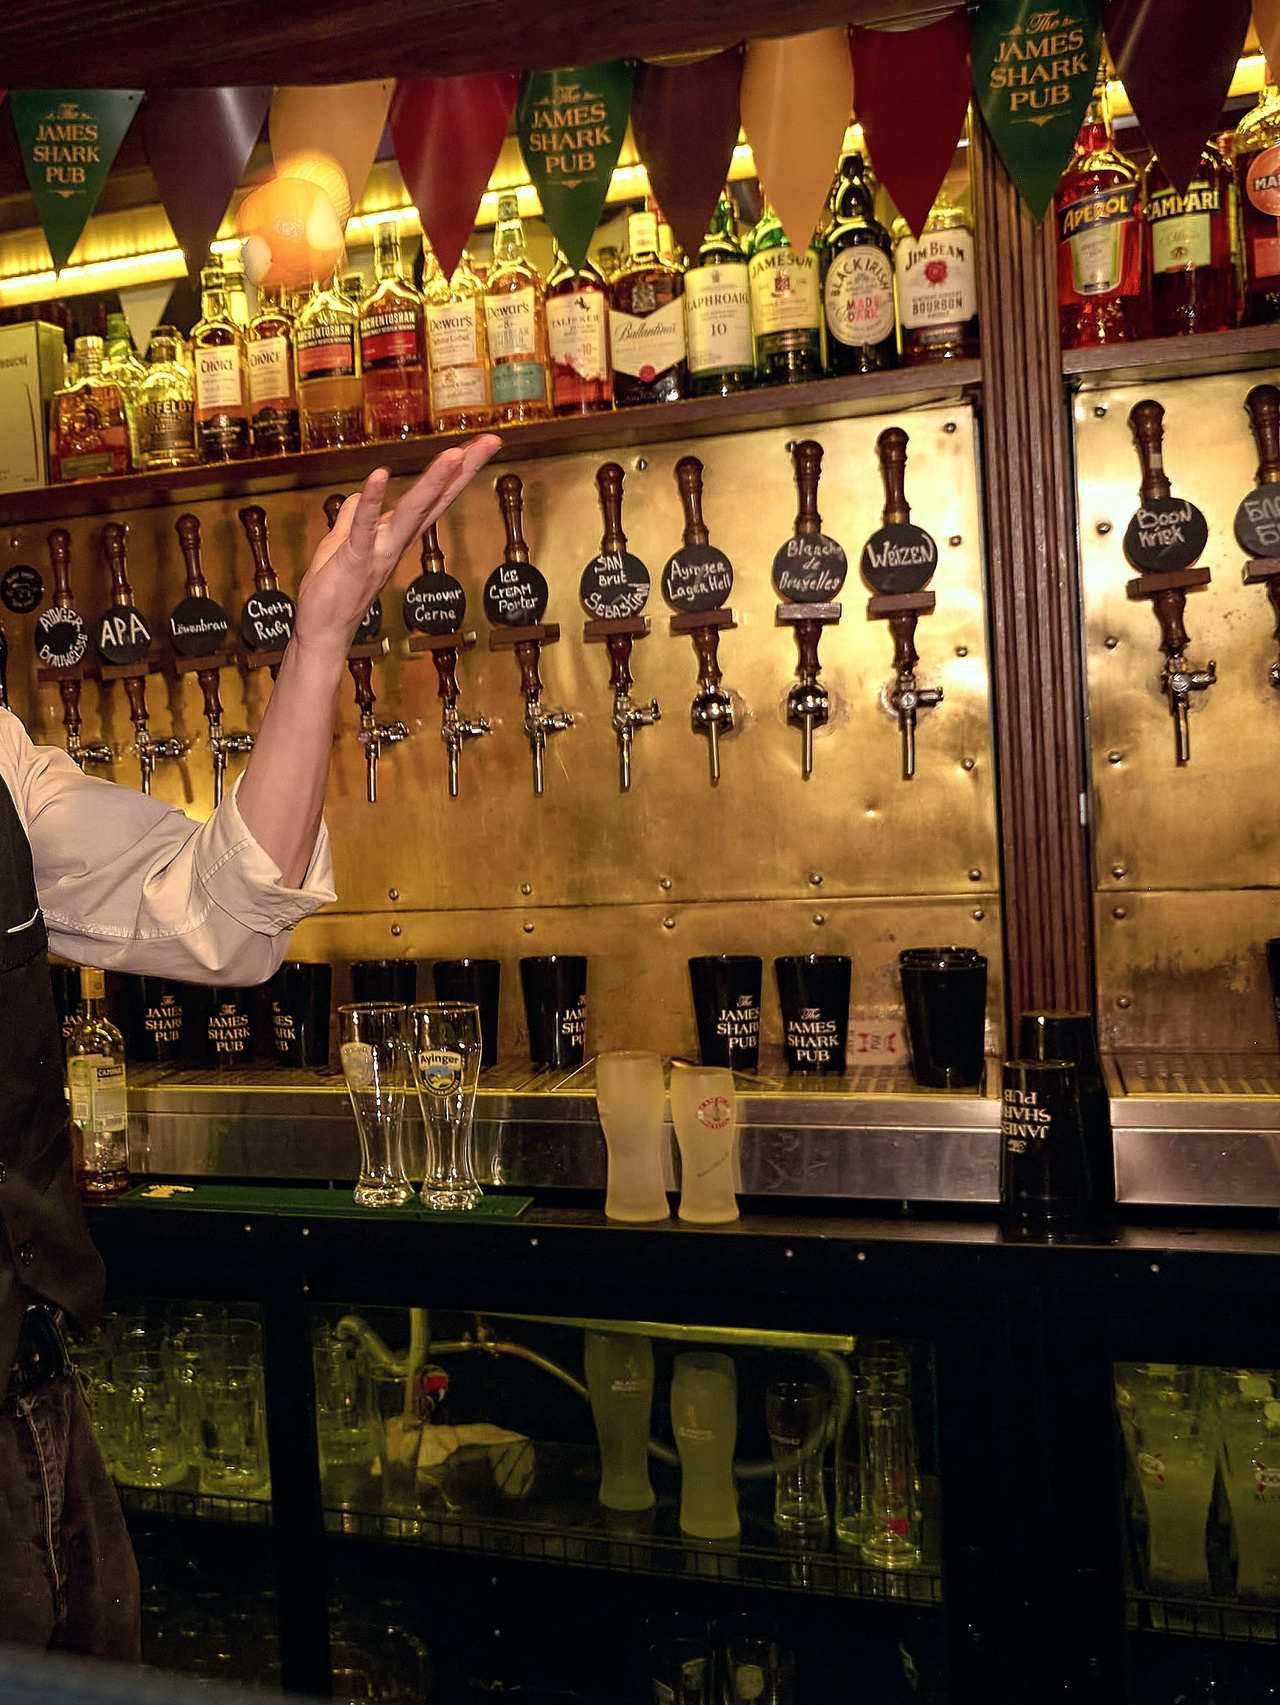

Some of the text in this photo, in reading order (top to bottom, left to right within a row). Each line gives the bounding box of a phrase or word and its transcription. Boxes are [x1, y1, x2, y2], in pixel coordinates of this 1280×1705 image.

[993, 29, 1084, 64] JAMES
[989, 53, 1089, 90] SHARK
[1009, 84, 1071, 112] PUB
[530, 102, 607, 130] JAMES
[35, 124, 99, 143] JAMES
[529, 125, 612, 153] SHARK
[32, 145, 100, 164] SHARK
[545, 152, 597, 175] PUB
[45, 166, 87, 185] PUB
[905, 242, 966, 271] JIM BEAM
[830, 257, 890, 297] BLACK IRISH
[711, 323, 727, 337] 10
[101, 612, 151, 649] APA
[144, 1005, 183, 1019] JAMES
[562, 1009, 586, 1022] JAM
[718, 1007, 761, 1021] JAMES
[208, 1014, 249, 1029] JAMES
[787, 1020, 837, 1035] JAMES
[154, 1030, 180, 1042] PUB
[208, 1025, 251, 1040] SHARK
[216, 1040, 245, 1053] PUB
[571, 1035, 586, 1047] PU
[728, 1036, 757, 1051] PUB
[787, 1033, 840, 1049] SHARK
[420, 1053, 461, 1066] Ayinger
[796, 1047, 831, 1063] PUB
[1005, 1088, 1038, 1106] PUB
